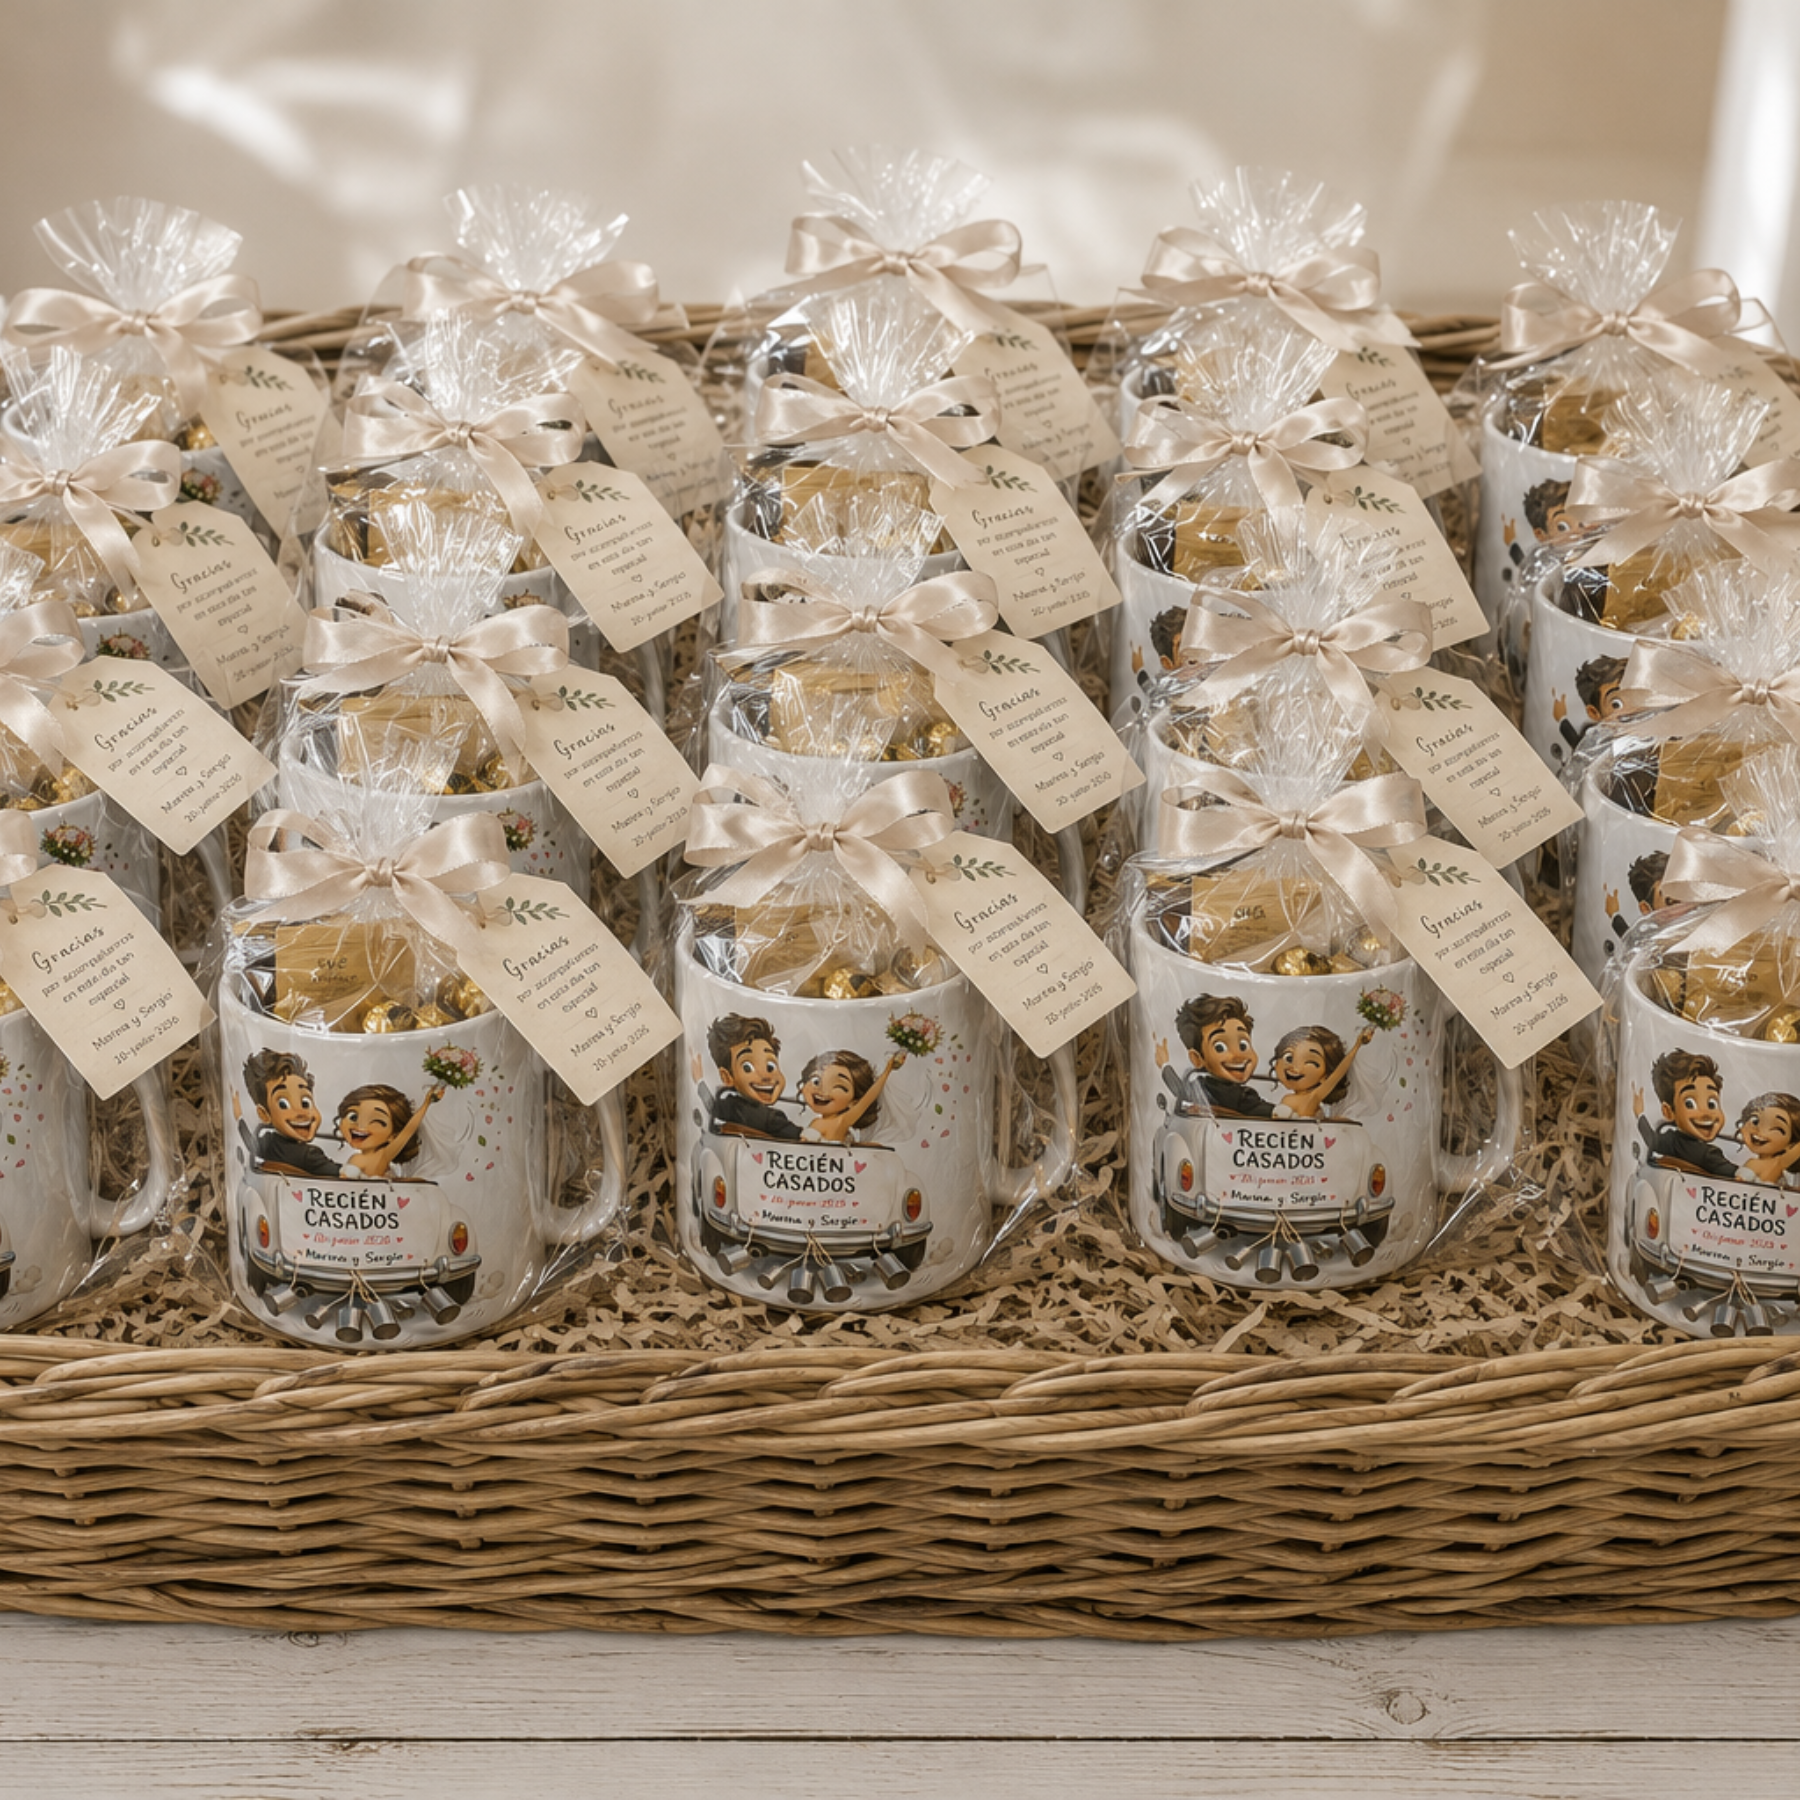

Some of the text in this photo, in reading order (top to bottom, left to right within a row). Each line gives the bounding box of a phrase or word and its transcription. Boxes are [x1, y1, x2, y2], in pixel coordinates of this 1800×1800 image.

[563, 514, 627, 546] Gracias
[971, 505, 1034, 541] Gracias
[170, 560, 232, 595] Gracias
[978, 688, 1041, 722] Gracias
[94, 707, 157, 753] Gracias
[553, 723, 615, 761] Gracias
[1415, 723, 1474, 758] Gracias
[1070, 767, 1078, 778] y
[644, 806, 653, 817] y
[1509, 799, 1518, 813] y
[953, 893, 1018, 934] Gracias
[1420, 899, 1483, 940] Gracias
[31, 926, 105, 975] Gracias
[502, 936, 569, 982] Gracias
[1056, 980, 1067, 992] y
[1522, 990, 1533, 1002] y
[131, 1016, 142, 1028] y
[604, 1023, 615, 1036] y
[1233, 1148, 1325, 1170] CASADOS
[763, 1170, 855, 1194] CASADOS
[1277, 1196, 1284, 1208] y
[304, 1208, 399, 1230] CASADOS
[808, 1217, 815, 1229] y
[1695, 1205, 1786, 1237] CASADOS
[352, 1256, 360, 1267] y
